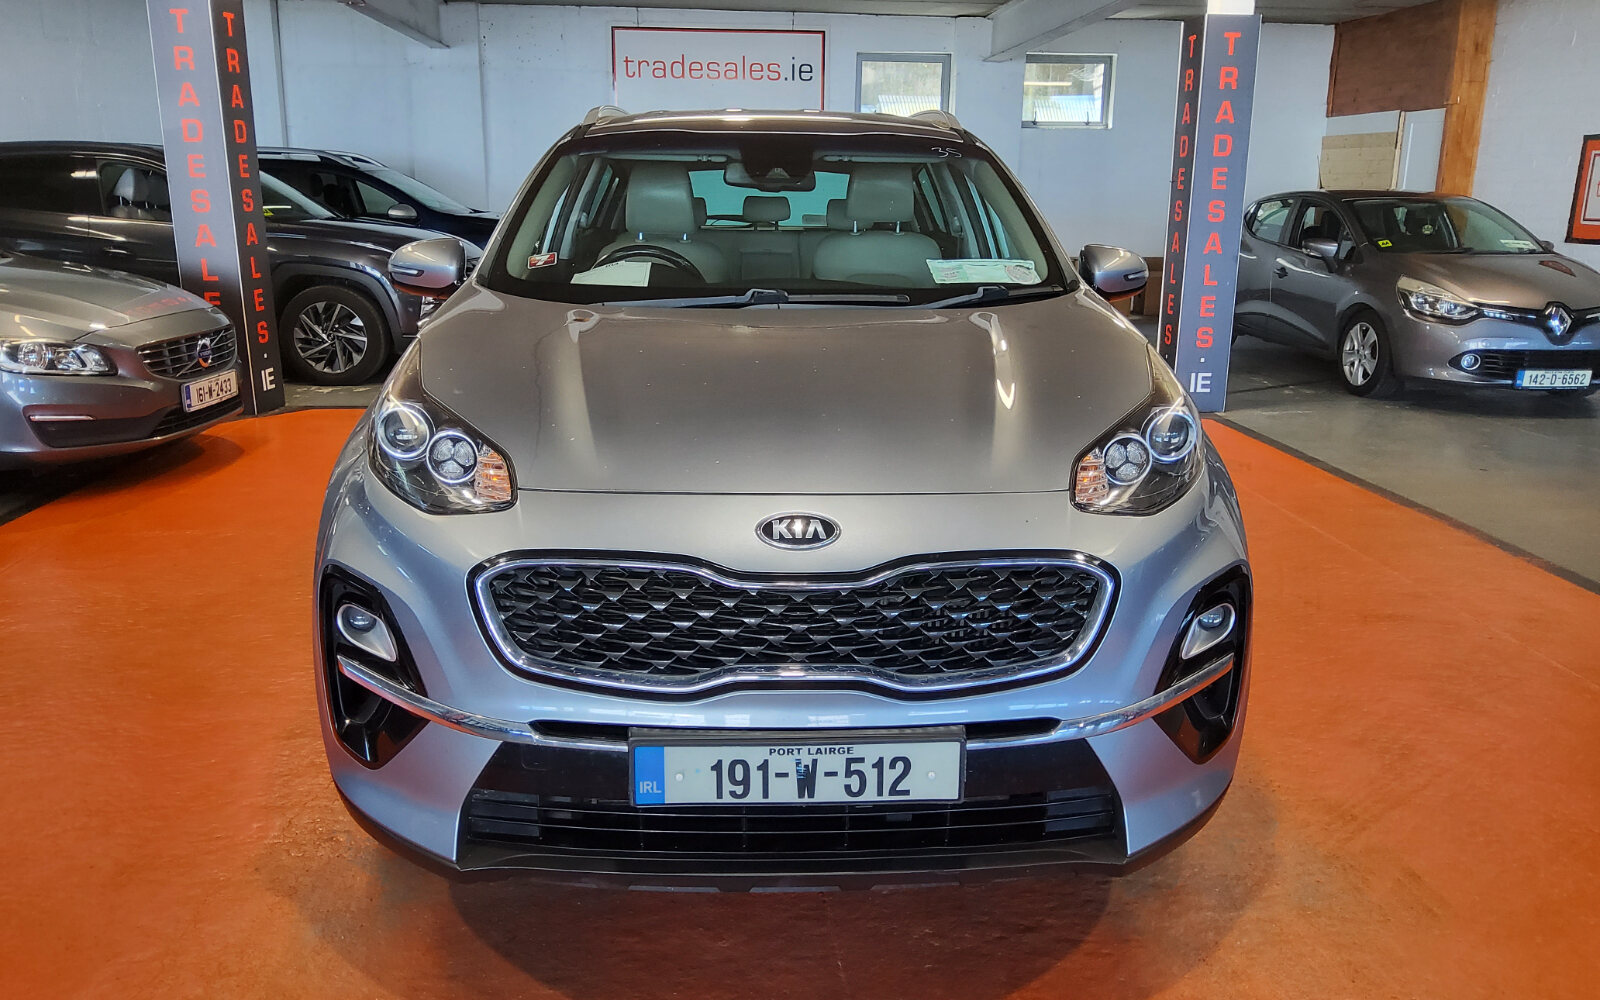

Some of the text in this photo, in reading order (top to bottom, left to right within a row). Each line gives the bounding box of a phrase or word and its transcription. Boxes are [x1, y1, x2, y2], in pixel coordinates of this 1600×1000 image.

[623, 54, 814, 82] tradesales.ie
[1528, 373, 1587, 386] 142-D-6562
[195, 378, 232, 403] 161-W-2433
[771, 519, 827, 540] KIA
[769, 746, 855, 757] PORT LAIRGE
[639, 781, 662, 794] IRL
[710, 756, 912, 800] 191-W-512
